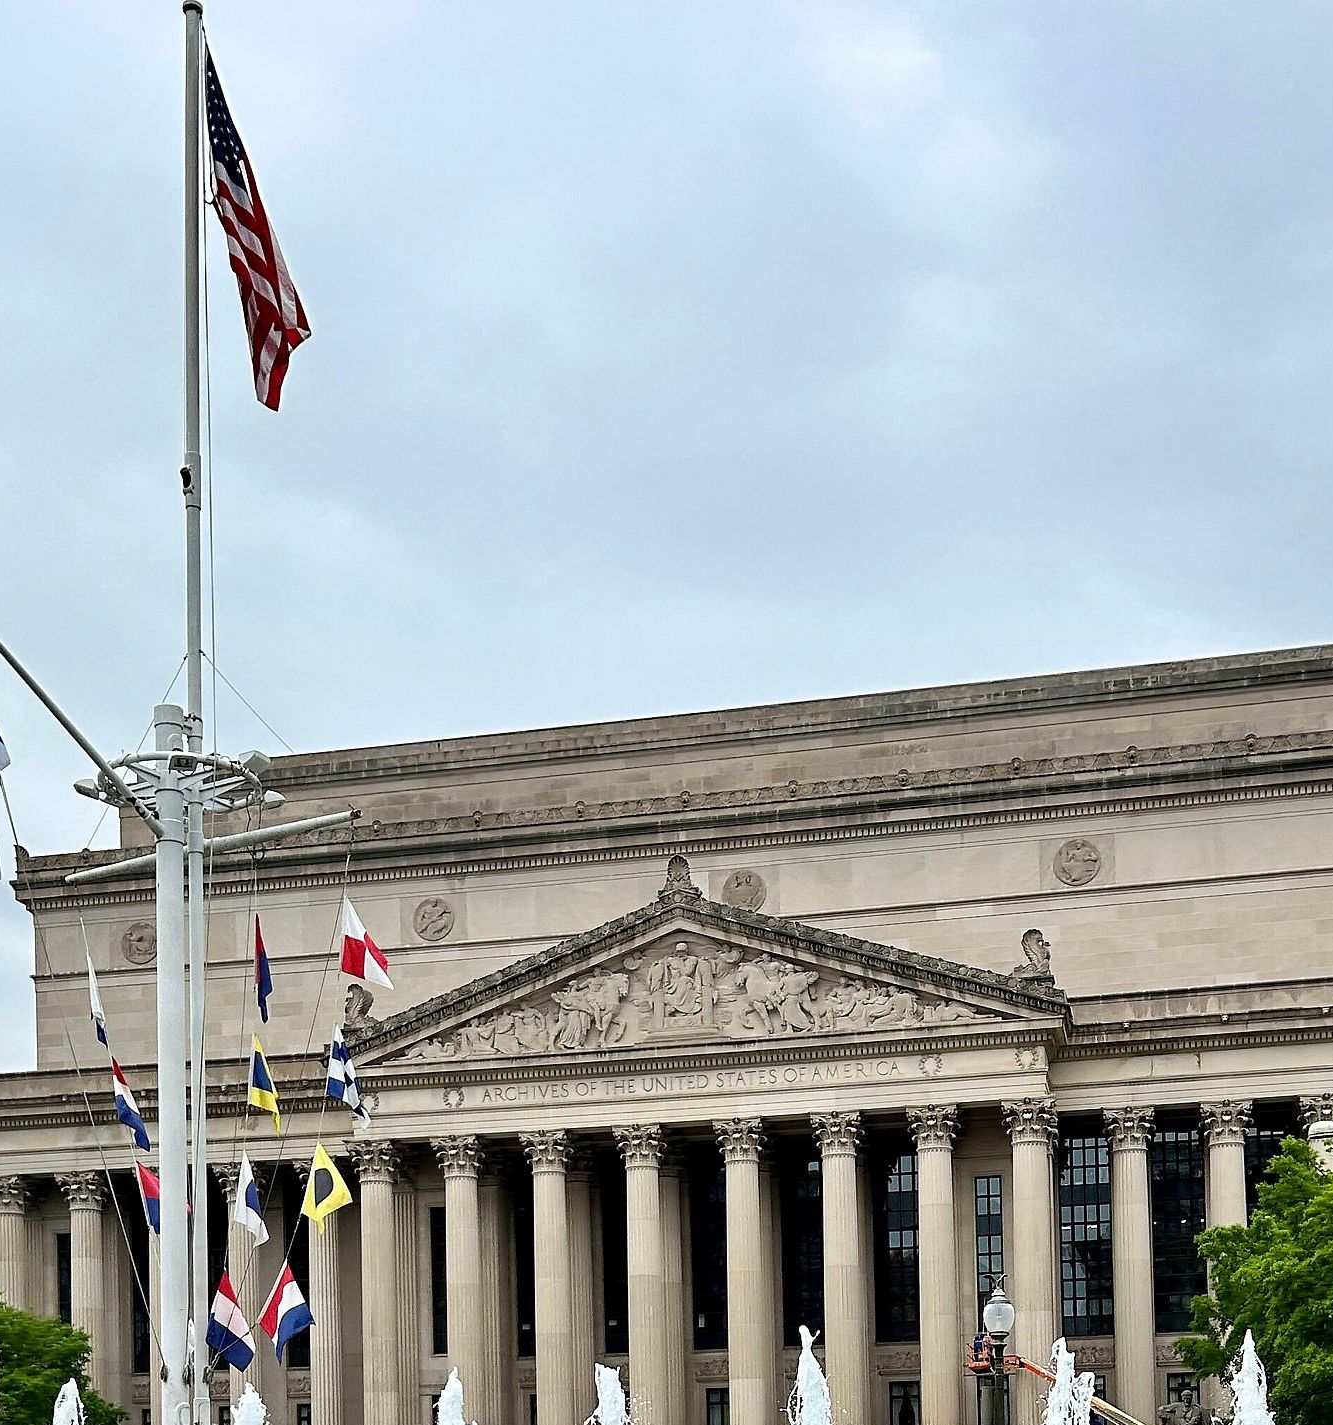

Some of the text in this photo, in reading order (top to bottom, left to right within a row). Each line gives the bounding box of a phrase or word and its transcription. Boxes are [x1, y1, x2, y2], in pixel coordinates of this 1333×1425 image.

[482, 1060, 901, 1103] ARCHIVES OF THE UNITED STATES OF AMERICA
